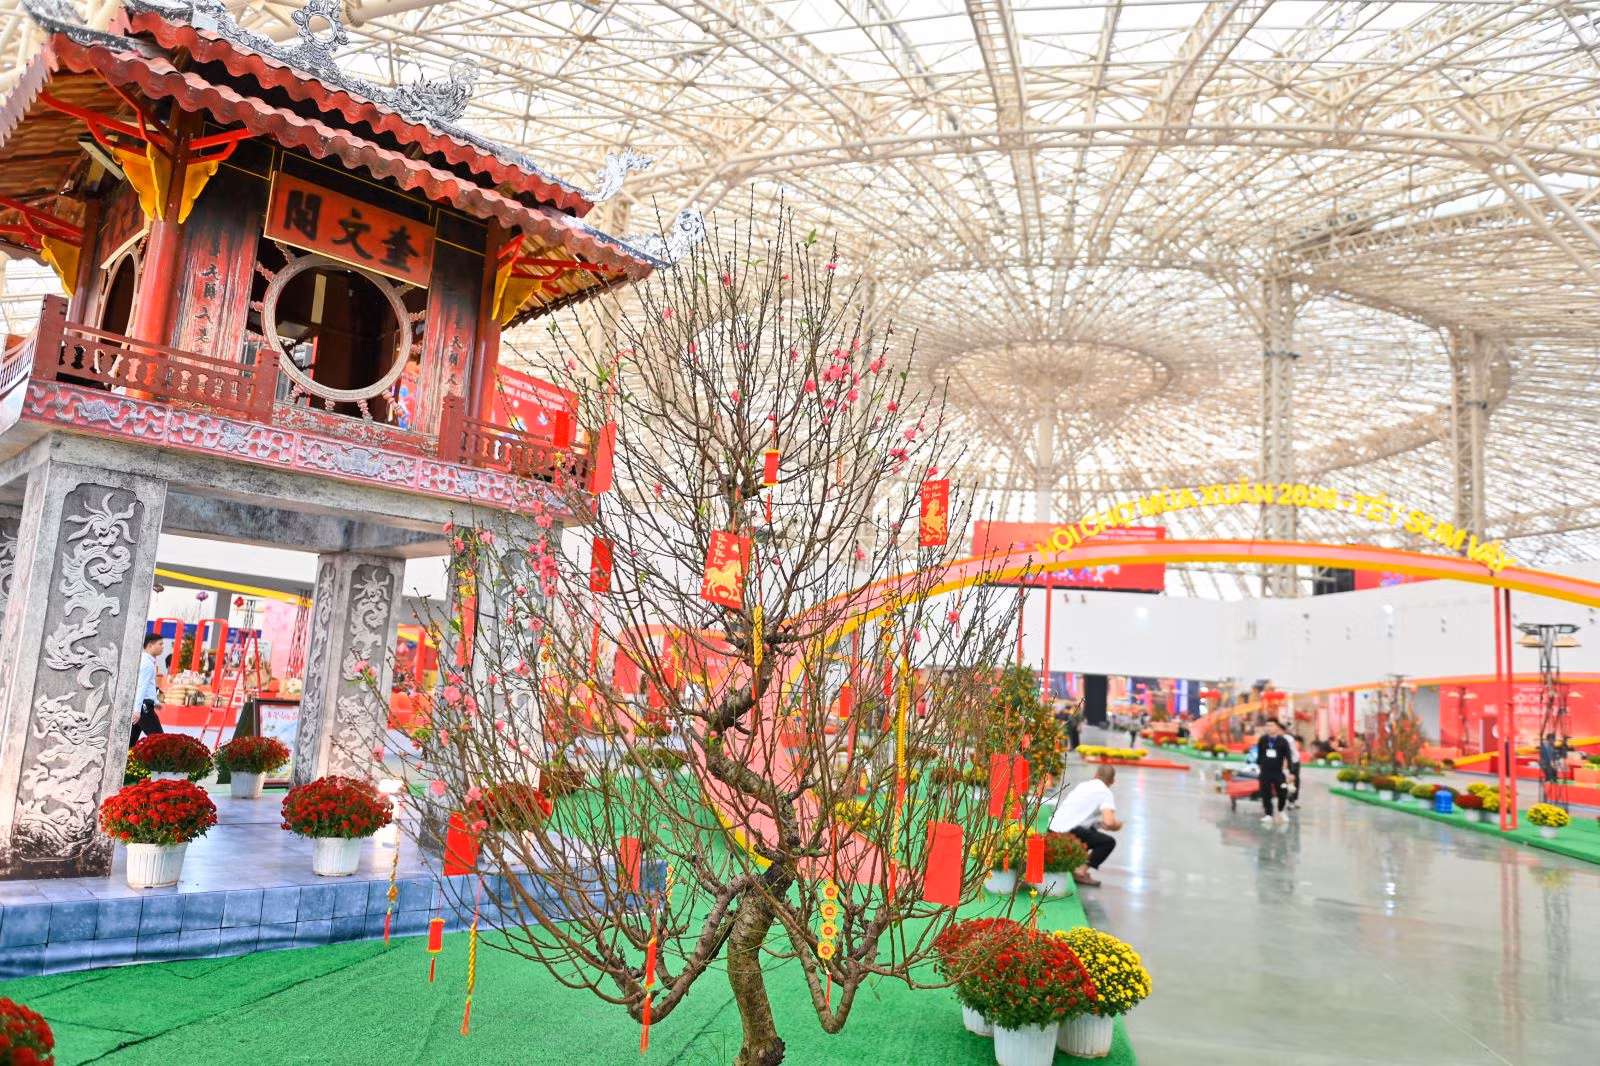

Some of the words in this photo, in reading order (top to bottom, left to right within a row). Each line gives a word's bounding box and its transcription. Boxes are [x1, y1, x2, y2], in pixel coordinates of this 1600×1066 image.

[1138, 486, 1201, 517] MÙA
[1200, 477, 1276, 504] XUÂN
[1404, 509, 1467, 551] SUM
